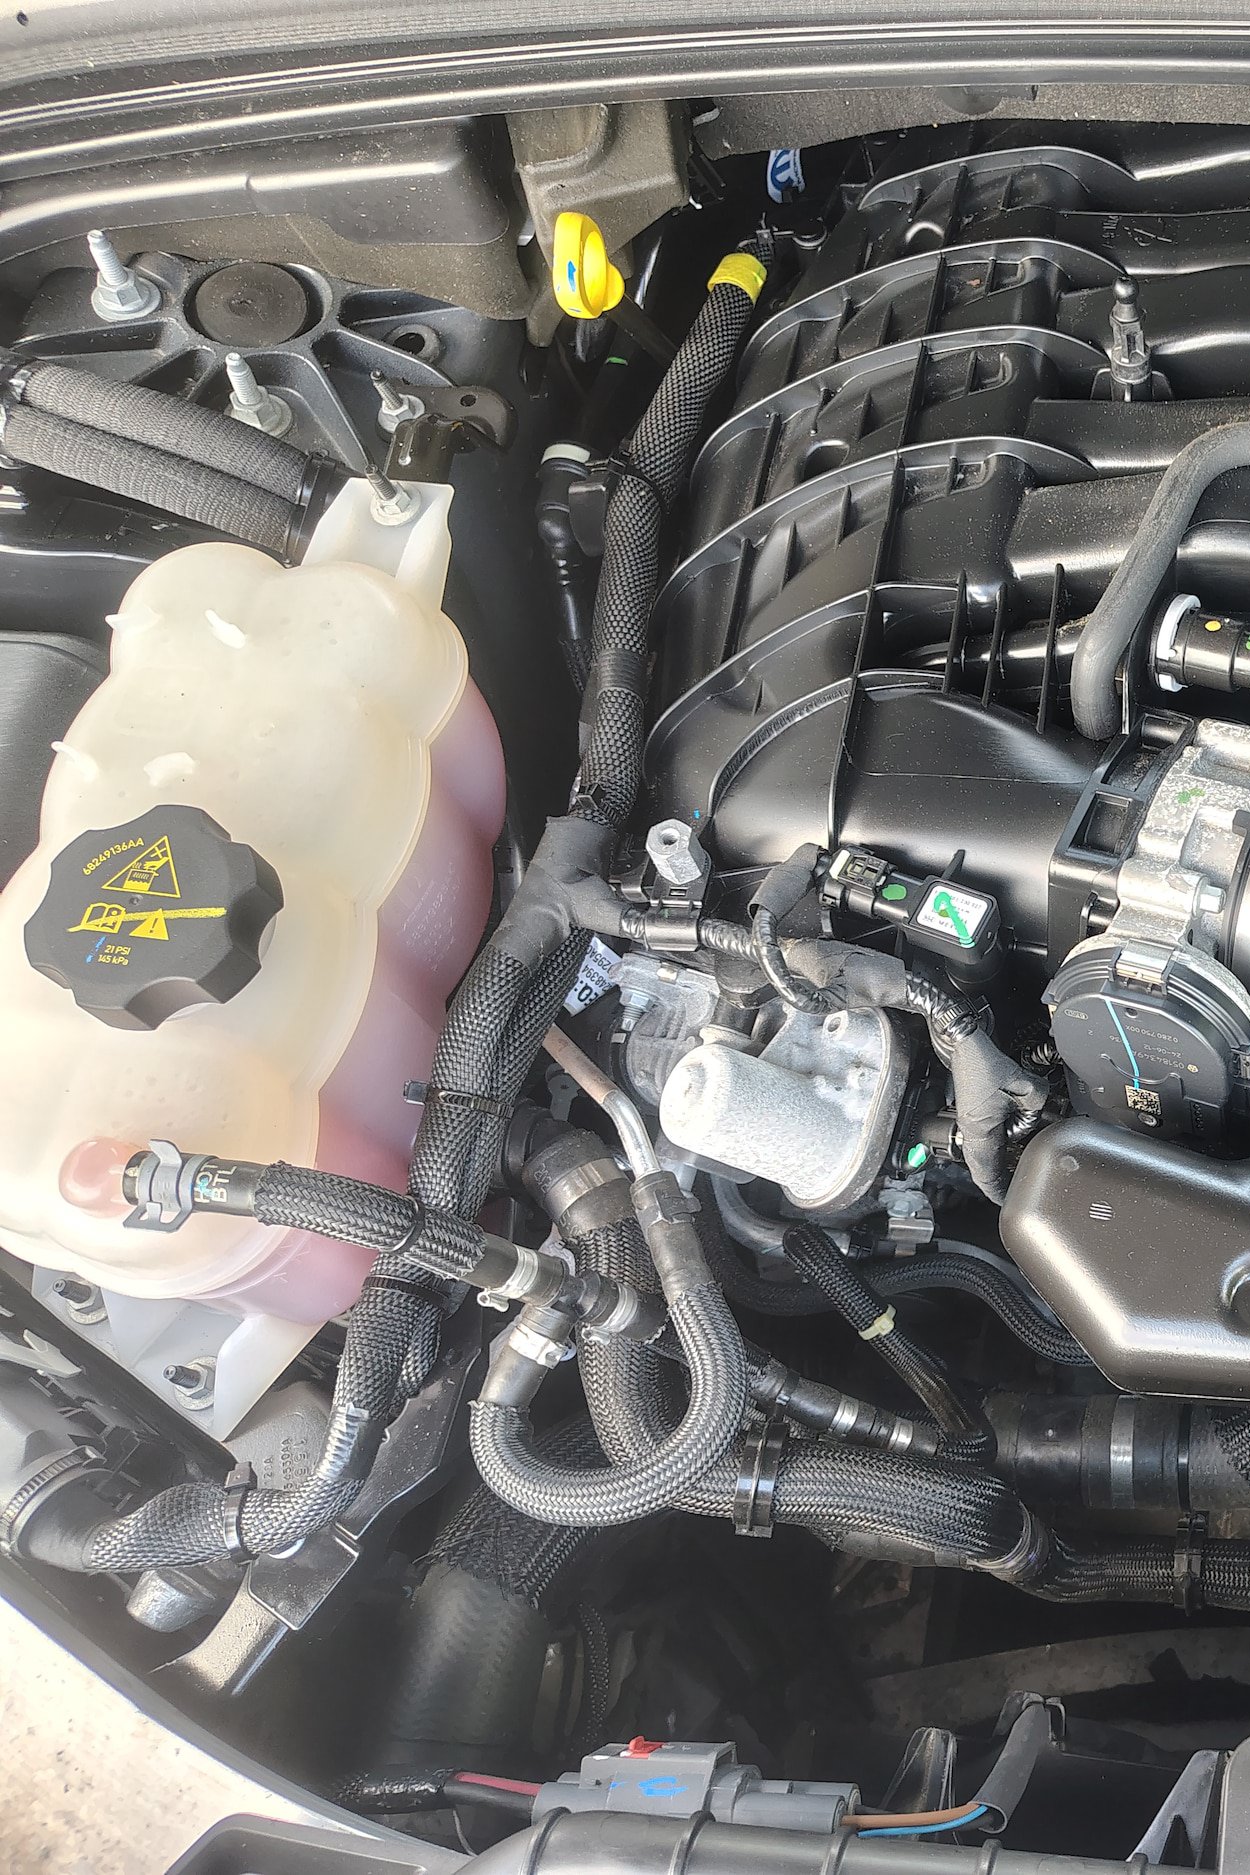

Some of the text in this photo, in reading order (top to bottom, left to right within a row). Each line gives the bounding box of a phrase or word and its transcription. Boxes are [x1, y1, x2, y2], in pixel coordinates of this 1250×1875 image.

[82, 837, 144, 876] 68249136AA
[98, 954, 129, 965] 145 kPa
[104, 945, 131, 955] 21 PSI
[211, 1165, 237, 1202] BTL
